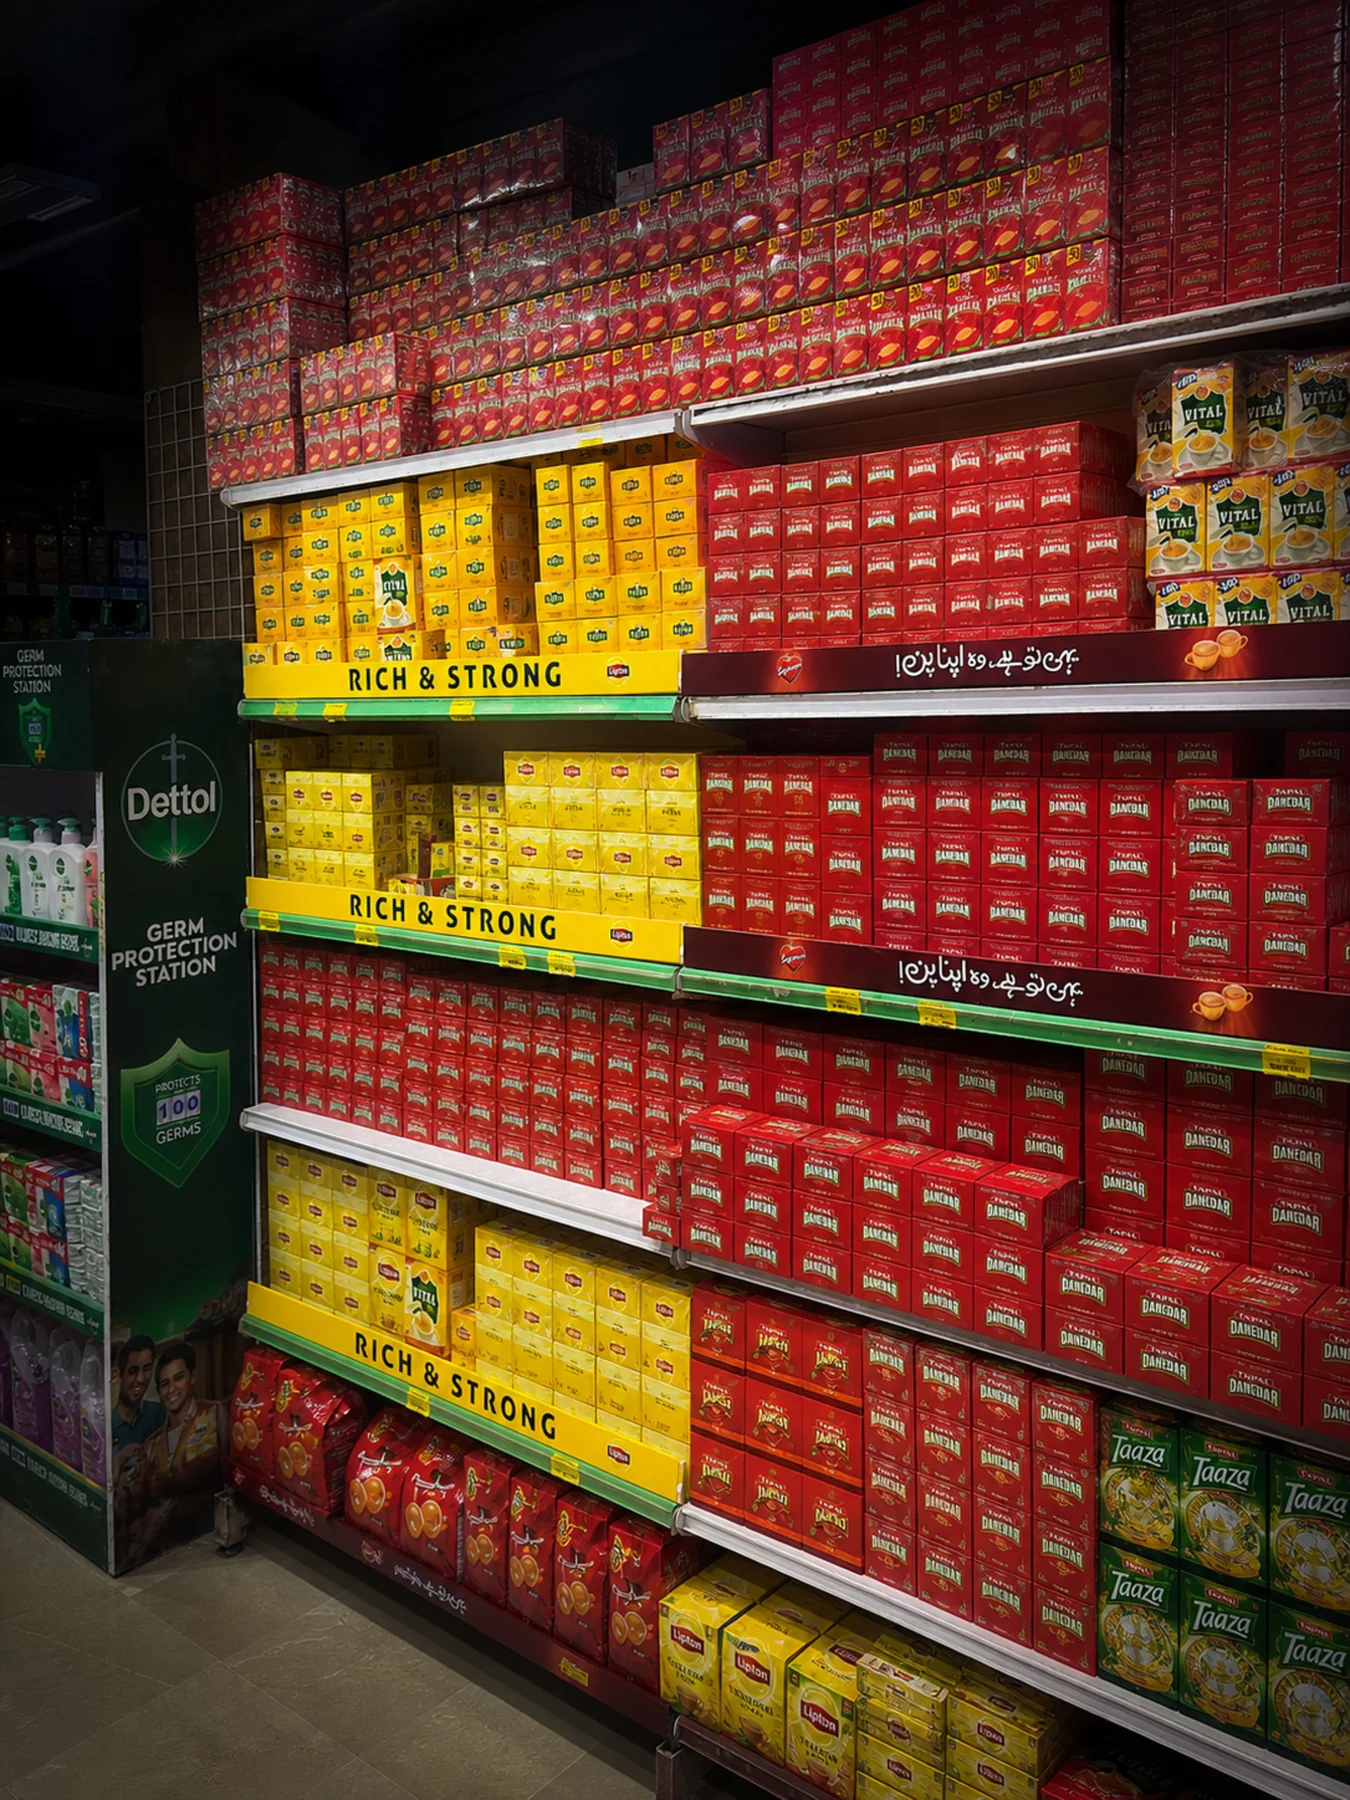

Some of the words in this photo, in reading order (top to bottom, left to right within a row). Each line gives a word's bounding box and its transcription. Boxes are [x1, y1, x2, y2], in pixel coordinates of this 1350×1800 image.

[1185, 403, 1224, 422] VITAL
[1220, 508, 1259, 525] VITAL
[1282, 500, 1324, 517] VITAL
[1158, 515, 1196, 530] VITAL
[1168, 611, 1206, 626] VITAL
[1227, 607, 1267, 624] VITAL
[1290, 605, 1330, 620] VITAL
[16, 649, 45, 663] GERM
[3, 664, 62, 679] PROTECTION
[348, 666, 406, 692] RICH
[419, 666, 435, 690] &
[448, 661, 562, 690] STRONG
[13, 679, 51, 693] STATION
[127, 781, 217, 822] Dettol
[350, 894, 406, 922] RICH
[417, 903, 433, 926] &
[446, 904, 556, 940] STRONG
[147, 917, 204, 943] GERM
[112, 931, 238, 971] PROTECTION
[135, 956, 217, 988] STATION
[155, 1075, 200, 1093] PROTECTS
[158, 1095, 199, 1119] 100
[156, 1122, 201, 1144] GERMS
[1103, 1115, 1144, 1137] DANEDAR
[1186, 1132, 1230, 1154] DANEDAR
[1273, 1145, 1321, 1169] DANEDAR
[1103, 1175, 1145, 1197] DANEDAR
[1186, 1192, 1230, 1216] DANEDAR
[1273, 1207, 1319, 1232] DANEDAR
[1062, 1277, 1104, 1302] DANEDAR
[1142, 1299, 1186, 1325] DANEDAR
[1061, 1330, 1103, 1357] DANEDAR
[1231, 1320, 1278, 1348] DANEDAR
[1143, 1353, 1186, 1380] DANEDAR
[355, 1332, 412, 1376] RICH
[424, 1362, 439, 1388] &
[451, 1374, 556, 1439] STRONG
[1230, 1378, 1278, 1406] DANEDAR
[1111, 1434, 1166, 1468] Taaza
[1193, 1456, 1251, 1491] Taaza
[1285, 1481, 1349, 1519] Taaza
[1110, 1570, 1165, 1606] Taaza
[1192, 1600, 1251, 1639] Taaza
[673, 1628, 703, 1650] Lipton
[1283, 1632, 1347, 1673] Taaza
[737, 1657, 769, 1682] Lipton
[803, 1703, 837, 1733] Lipton
